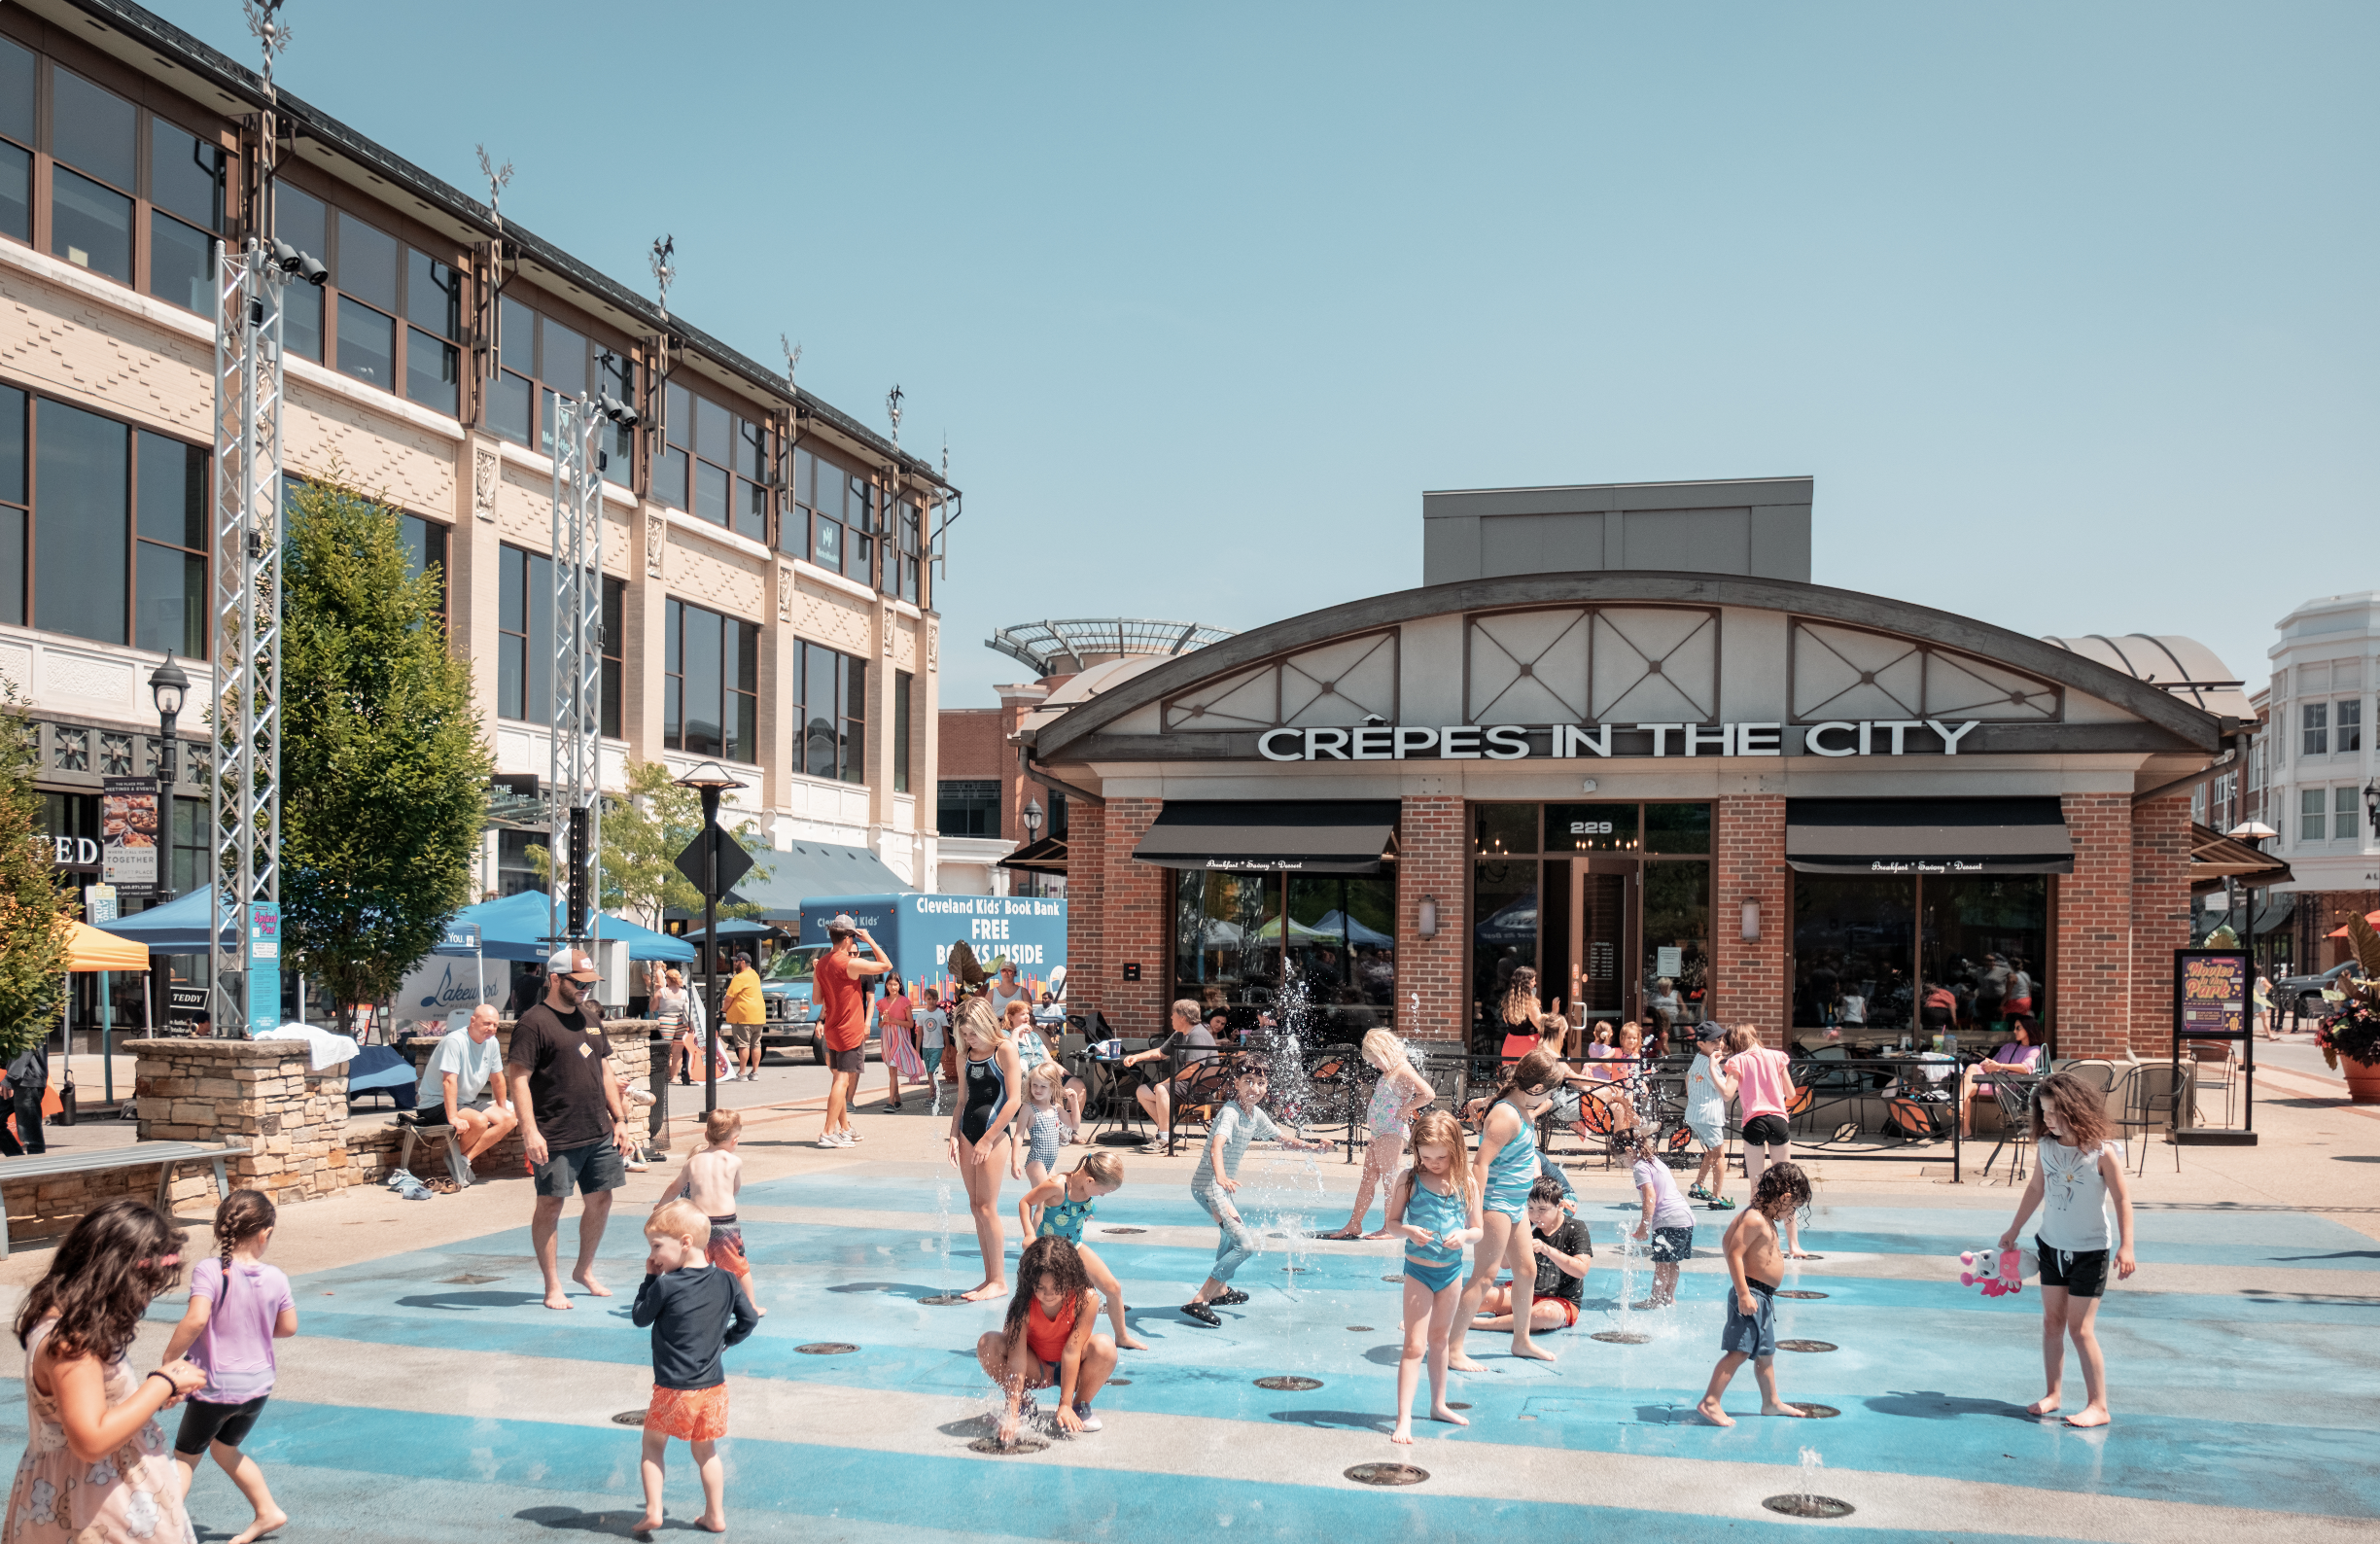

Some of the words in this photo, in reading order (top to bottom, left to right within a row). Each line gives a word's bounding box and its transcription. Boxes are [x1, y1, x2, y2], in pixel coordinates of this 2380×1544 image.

[1258, 713, 1530, 760] CRÊPES
[1553, 723, 1612, 758] IN
[1636, 721, 1780, 756] THE
[1805, 720, 1980, 756] CITY
[494, 785, 512, 793] THE
[1570, 822, 1612, 834] 229
[1206, 860, 1239, 870] Breakfast
[1246, 860, 1270, 870] Savory
[1278, 860, 1302, 869] Dessert
[1872, 861, 1908, 873] Breakfast
[1918, 861, 1944, 873] Savory
[1953, 860, 1982, 870] Dessert
[917, 897, 972, 914] Cleveland
[976, 898, 1002, 914] Kids'
[1005, 900, 1032, 915] Book
[1033, 901, 1060, 916] Bank
[254, 911, 278, 927] Splash
[859, 916, 879, 927] Kids'
[261, 923, 276, 934] Pad
[972, 919, 1009, 940] FREE
[936, 945, 990, 965] BKS
[993, 944, 1043, 965] INSIDE
[2188, 962, 2234, 978] Movies
[420, 963, 499, 1007] Lakewod
[2186, 978, 2231, 999] Park
[173, 994, 202, 1002] TEDDY
